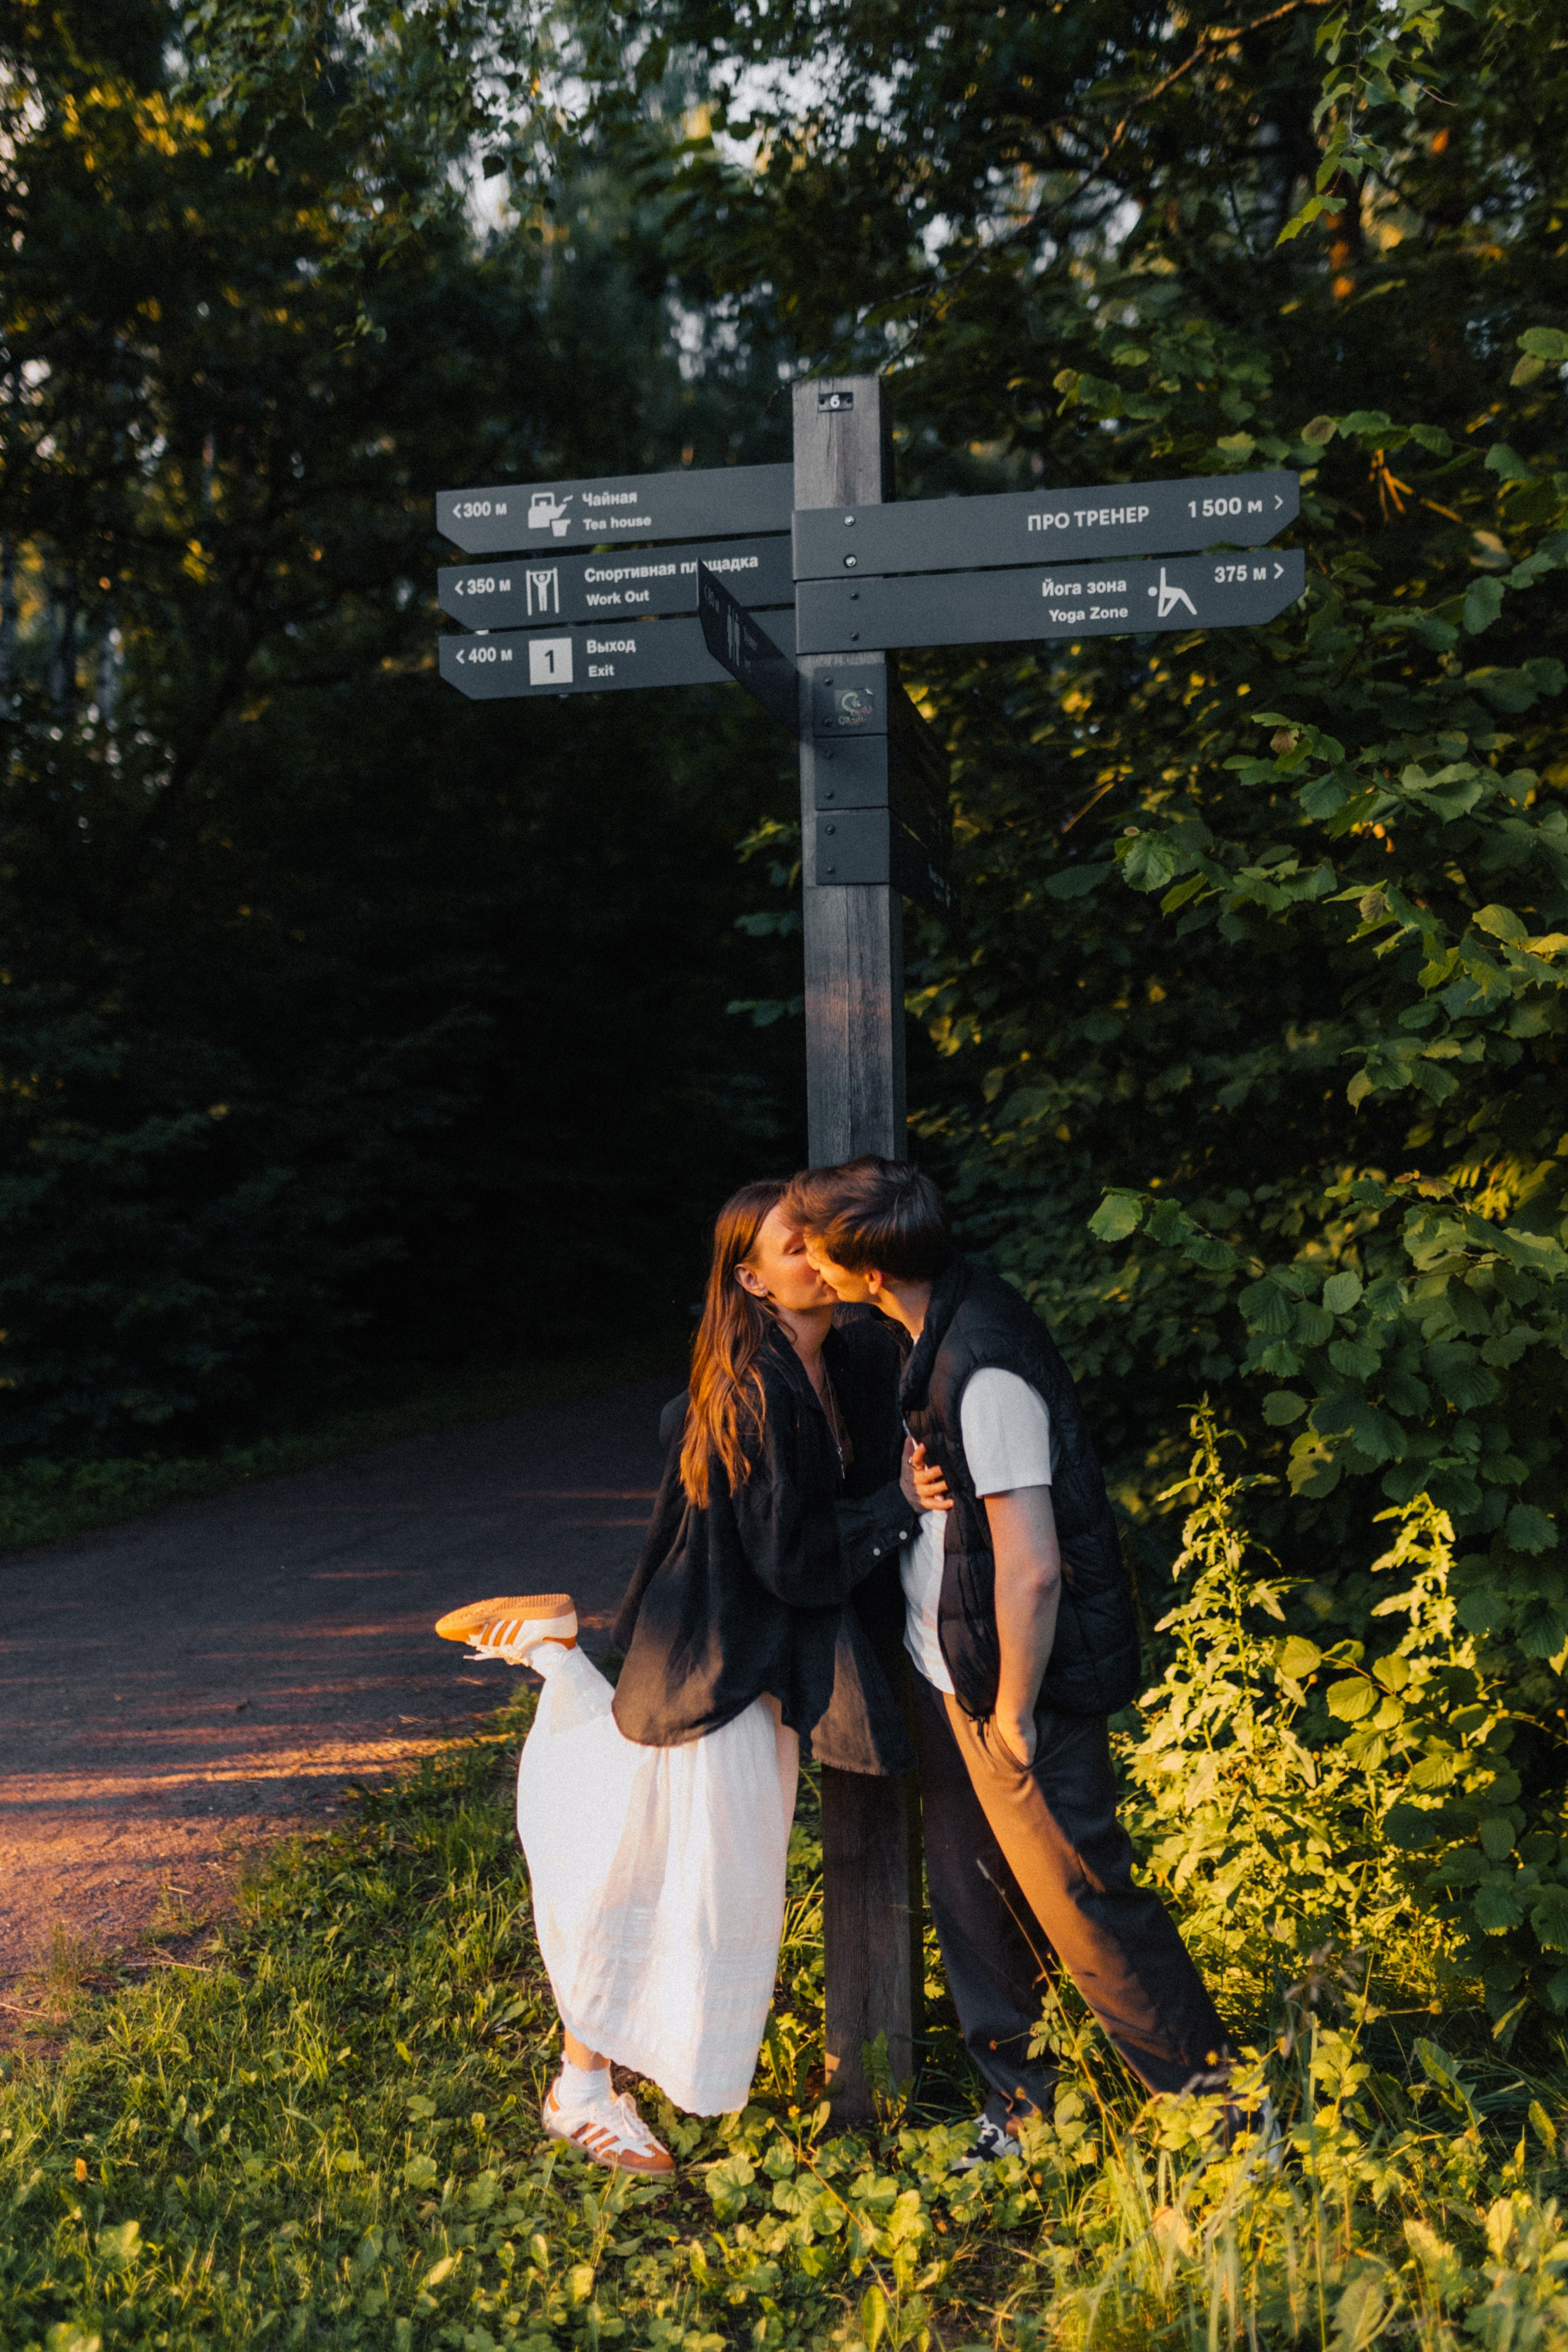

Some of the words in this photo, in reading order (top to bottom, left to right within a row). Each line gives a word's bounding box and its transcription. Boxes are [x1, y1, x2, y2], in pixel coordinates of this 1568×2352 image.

[830, 394, 840, 408] 6
[582, 491, 638, 507] Чайная
[463, 501, 491, 518] 300
[582, 518, 607, 530] Tea
[610, 516, 652, 529] house
[1028, 512, 1070, 532] ПРО
[1073, 505, 1150, 527] ТРЕНЕР
[584, 564, 676, 583] Спортивная
[1214, 565, 1248, 583] 375
[467, 577, 496, 595] 350
[1042, 578, 1082, 597] Йога
[1087, 580, 1127, 594] зона
[586, 592, 621, 606] Work
[624, 590, 650, 603] Out
[1049, 609, 1085, 624] Yoga
[1090, 606, 1128, 620] Zone
[468, 647, 497, 663] 400
[586, 639, 636, 654] Выход
[545, 650, 554, 673] 1
[588, 664, 614, 677] Exit
